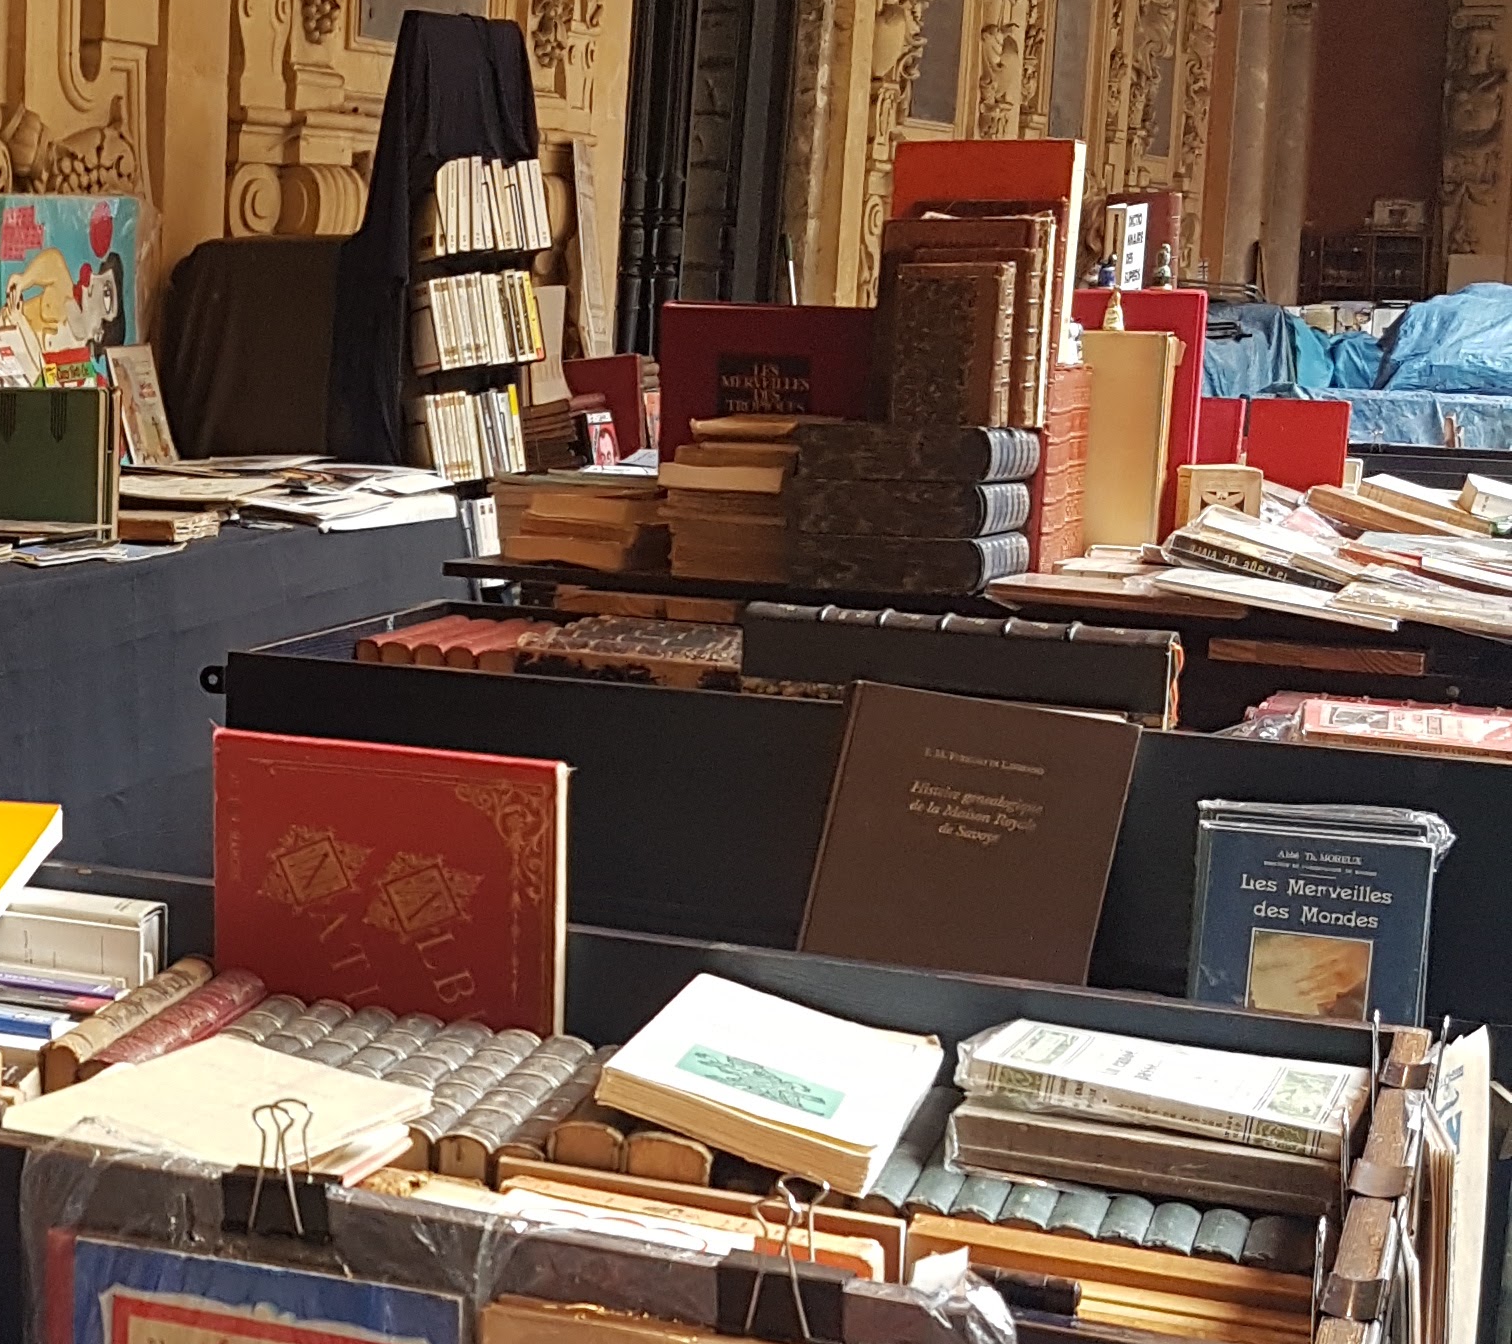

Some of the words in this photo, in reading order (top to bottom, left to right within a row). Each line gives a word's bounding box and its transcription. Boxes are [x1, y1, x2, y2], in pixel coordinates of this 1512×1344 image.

[909, 799, 925, 812] de
[926, 801, 941, 814] la
[942, 804, 991, 823] Maison
[938, 823, 954, 835] de
[1240, 874, 1278, 892] Les
[1287, 878, 1393, 905] Merveilles
[1253, 900, 1289, 919] des
[1300, 905, 1379, 929] Mondes
